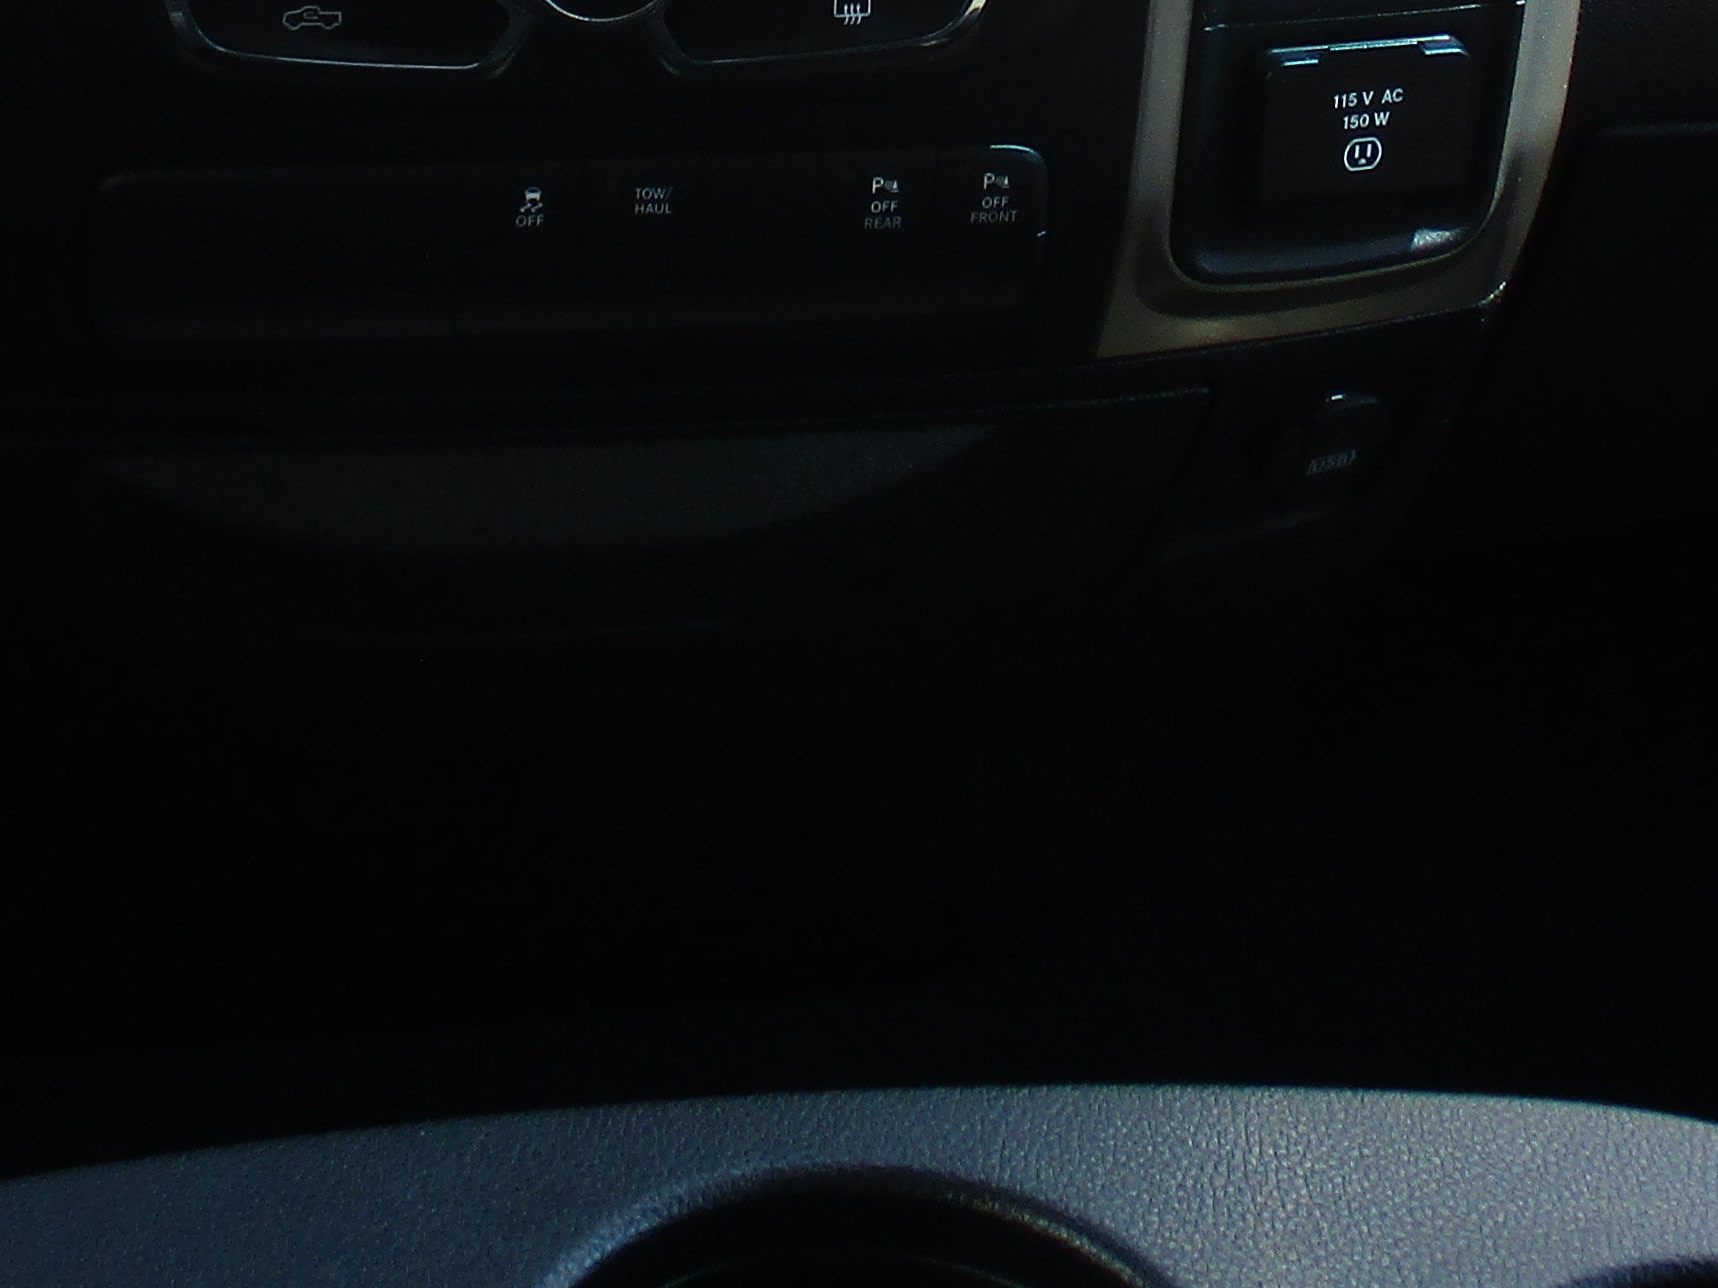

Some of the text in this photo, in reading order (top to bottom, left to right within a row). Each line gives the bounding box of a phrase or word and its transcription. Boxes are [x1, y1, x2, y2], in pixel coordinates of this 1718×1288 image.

[1334, 87, 1403, 109] 115 V AC
[1343, 111, 1390, 130] 150 W
[634, 202, 671, 214] HAUL
[870, 200, 897, 213] OFF
[981, 196, 1009, 209] OFF
[515, 213, 544, 228] OFF
[864, 215, 902, 229] REAR
[970, 210, 1018, 224] FRONT
